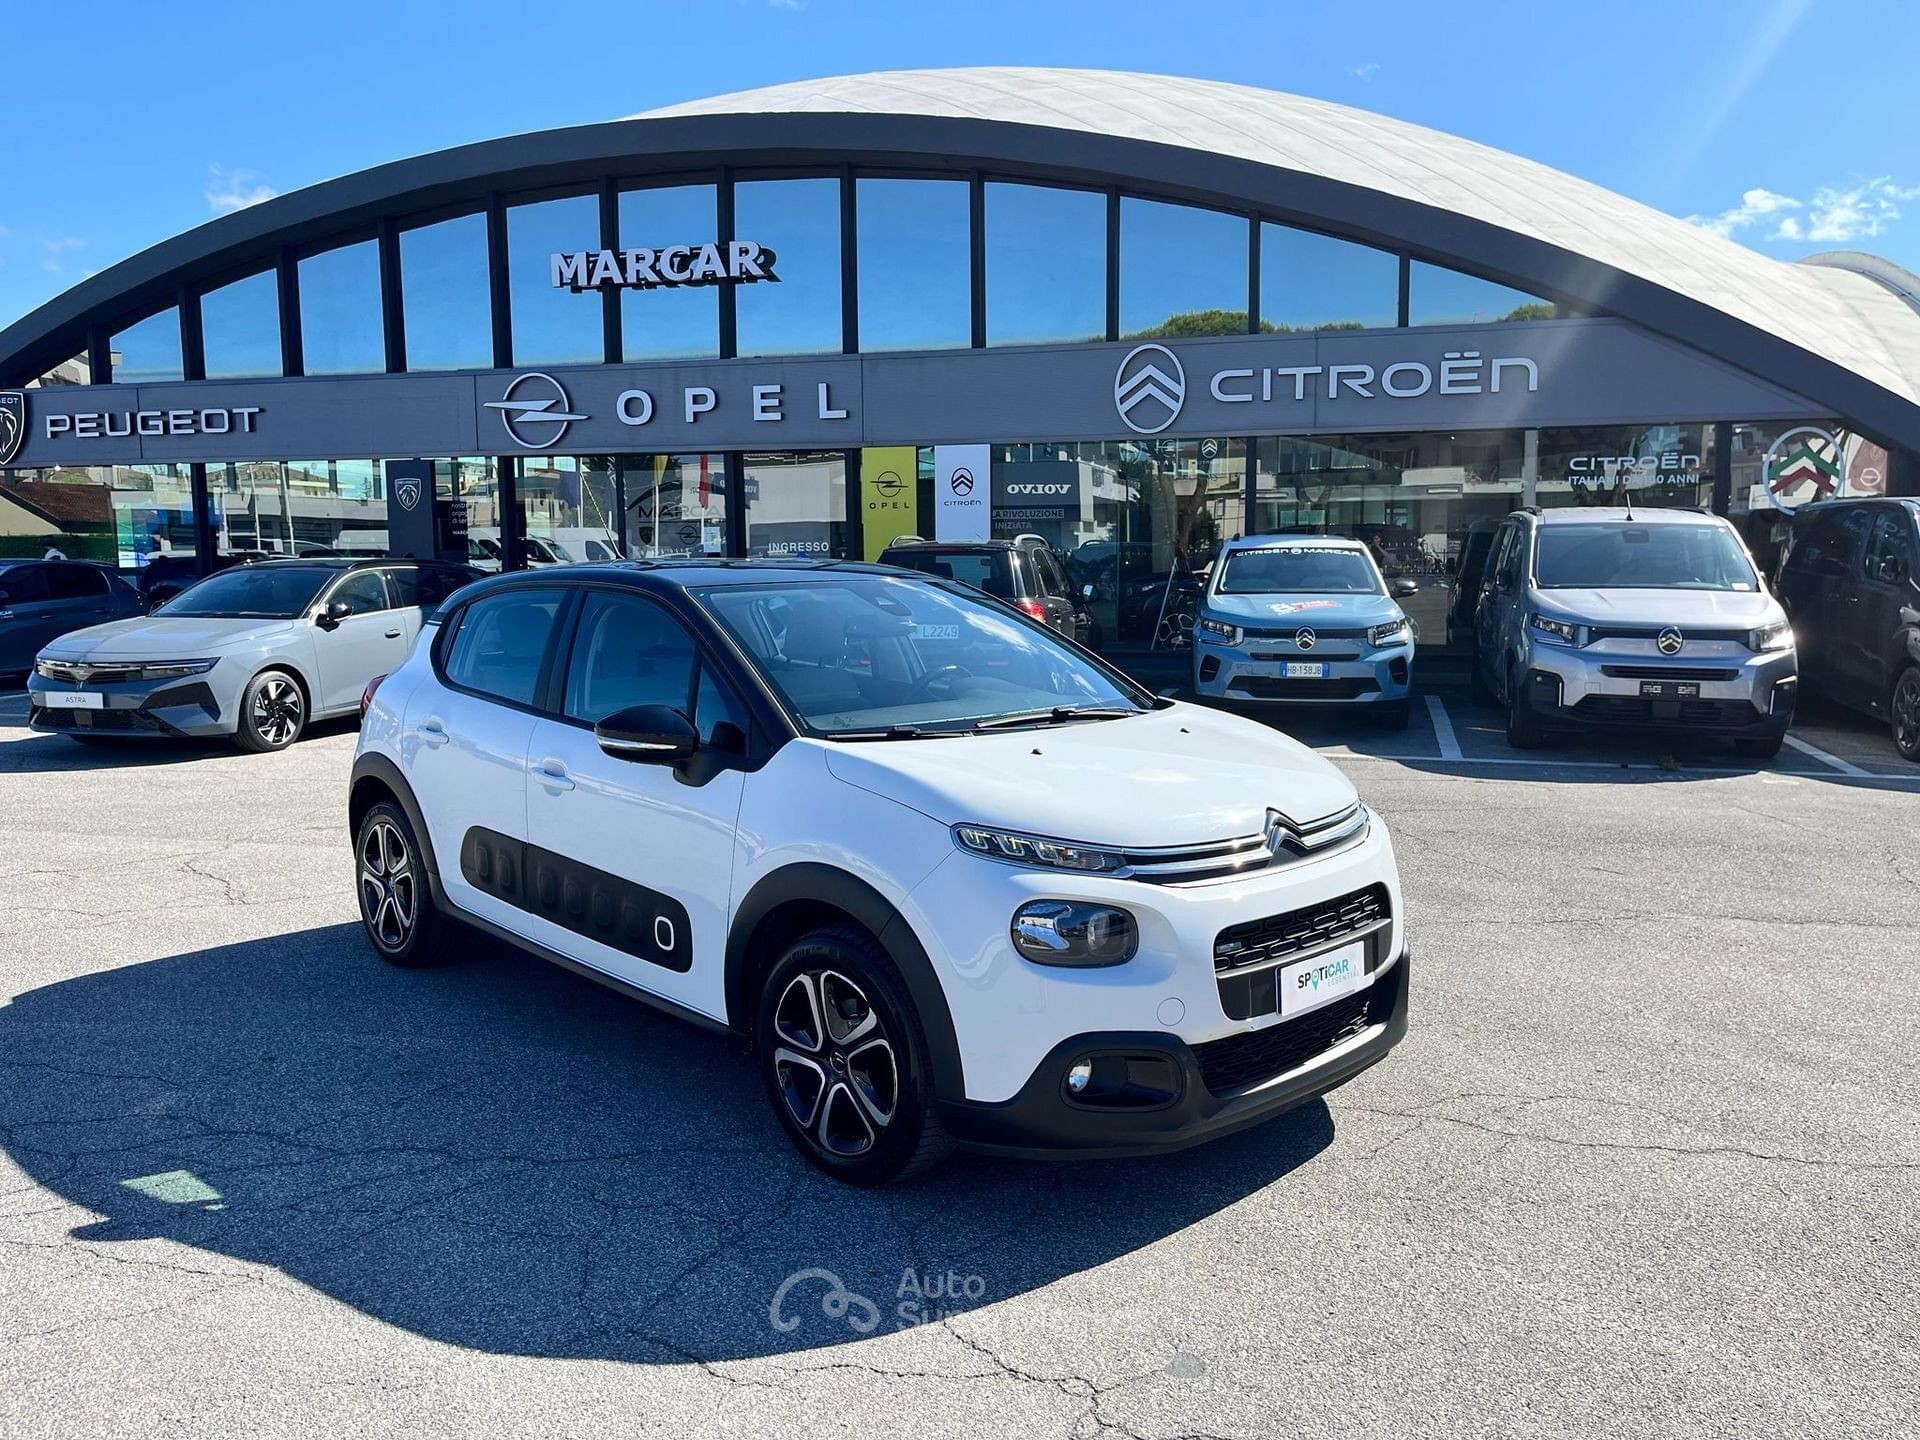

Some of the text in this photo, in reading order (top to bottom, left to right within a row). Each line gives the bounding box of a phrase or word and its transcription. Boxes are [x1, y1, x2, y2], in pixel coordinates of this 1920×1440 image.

[551, 241, 765, 287] MARCAR
[1210, 351, 1539, 402] CITROËN
[616, 383, 848, 426] OPEL
[46, 407, 260, 439] PEUGEOT
[1569, 452, 1700, 471] CITROËN
[1568, 475, 1619, 486] ITALIANI
[1667, 474, 1699, 484] ANNI
[869, 502, 910, 510] OPEL
[943, 499, 982, 507] CITROËN
[768, 542, 830, 552] INGRESSO
[922, 626, 958, 638] L2249
